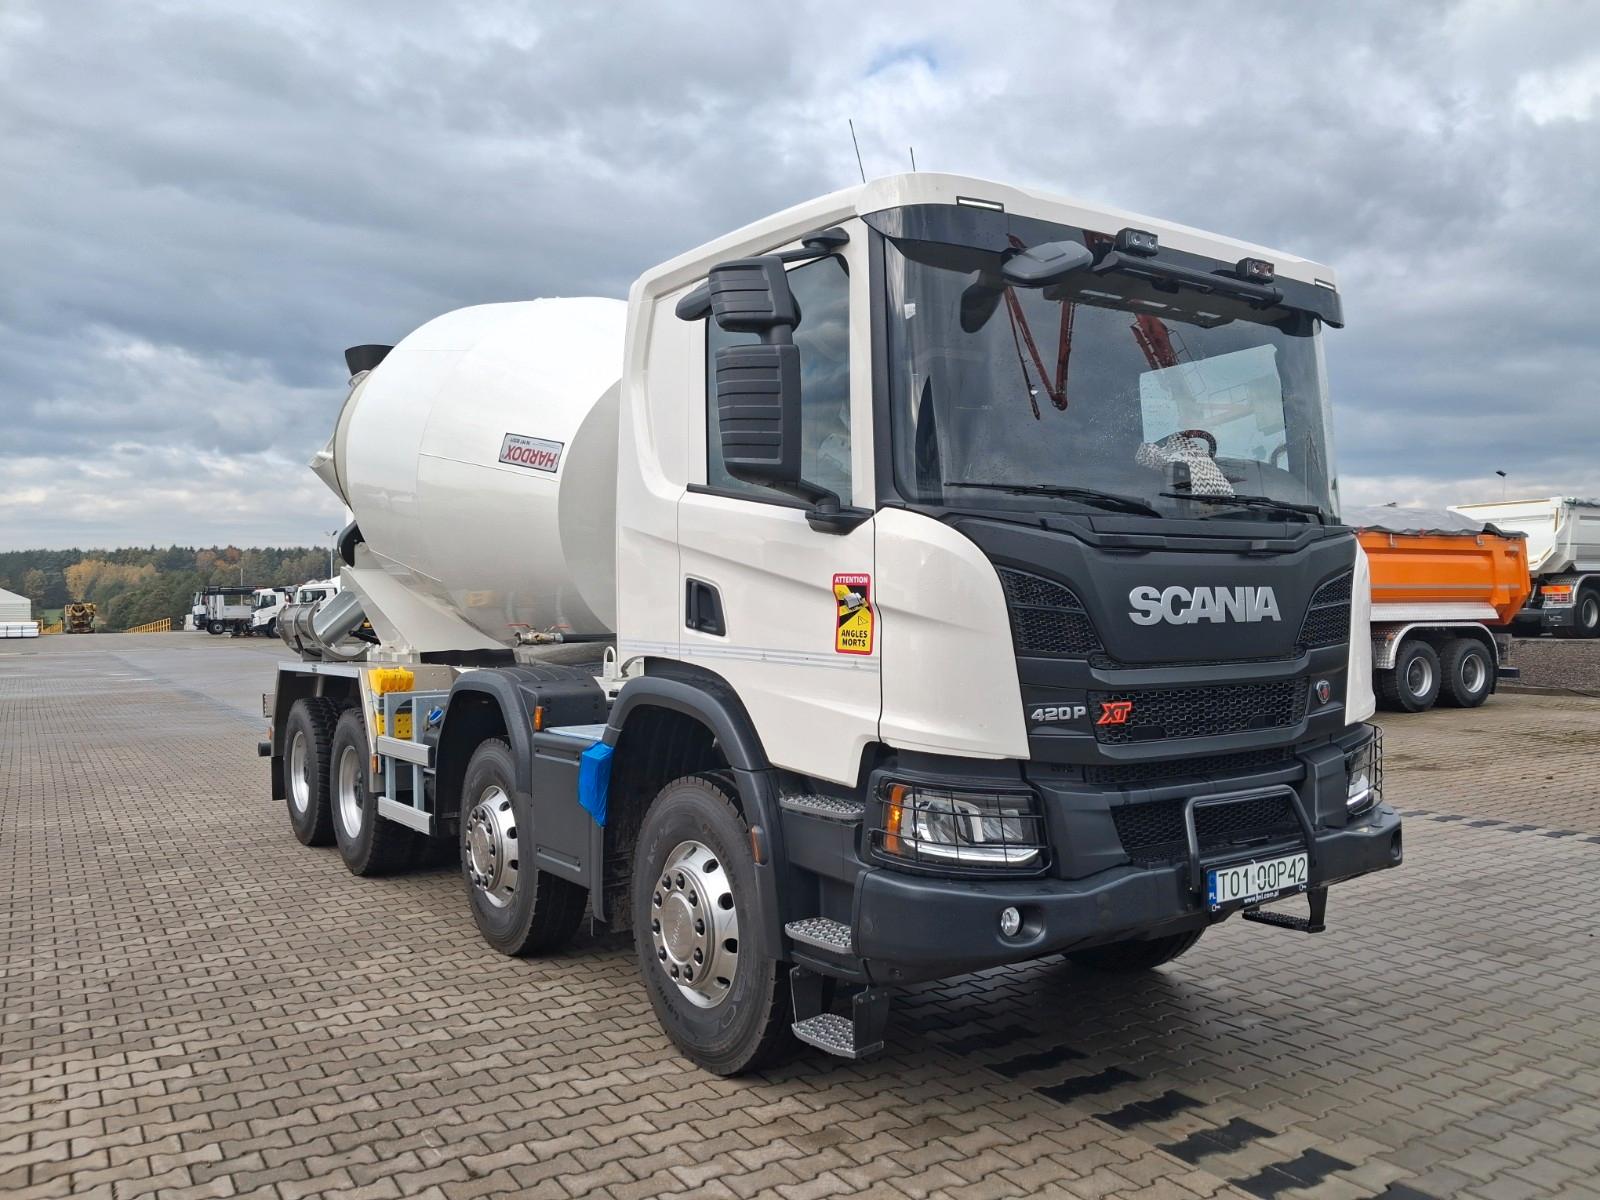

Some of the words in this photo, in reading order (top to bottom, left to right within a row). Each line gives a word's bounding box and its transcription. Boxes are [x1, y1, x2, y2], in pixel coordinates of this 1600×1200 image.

[504, 445, 557, 467] HARDOX
[835, 576, 868, 584] ATTENTION
[1128, 585, 1282, 626] SCANIA
[841, 629, 868, 639] ANGLES
[842, 639, 866, 648] MORTS
[1096, 701, 1133, 725] XT
